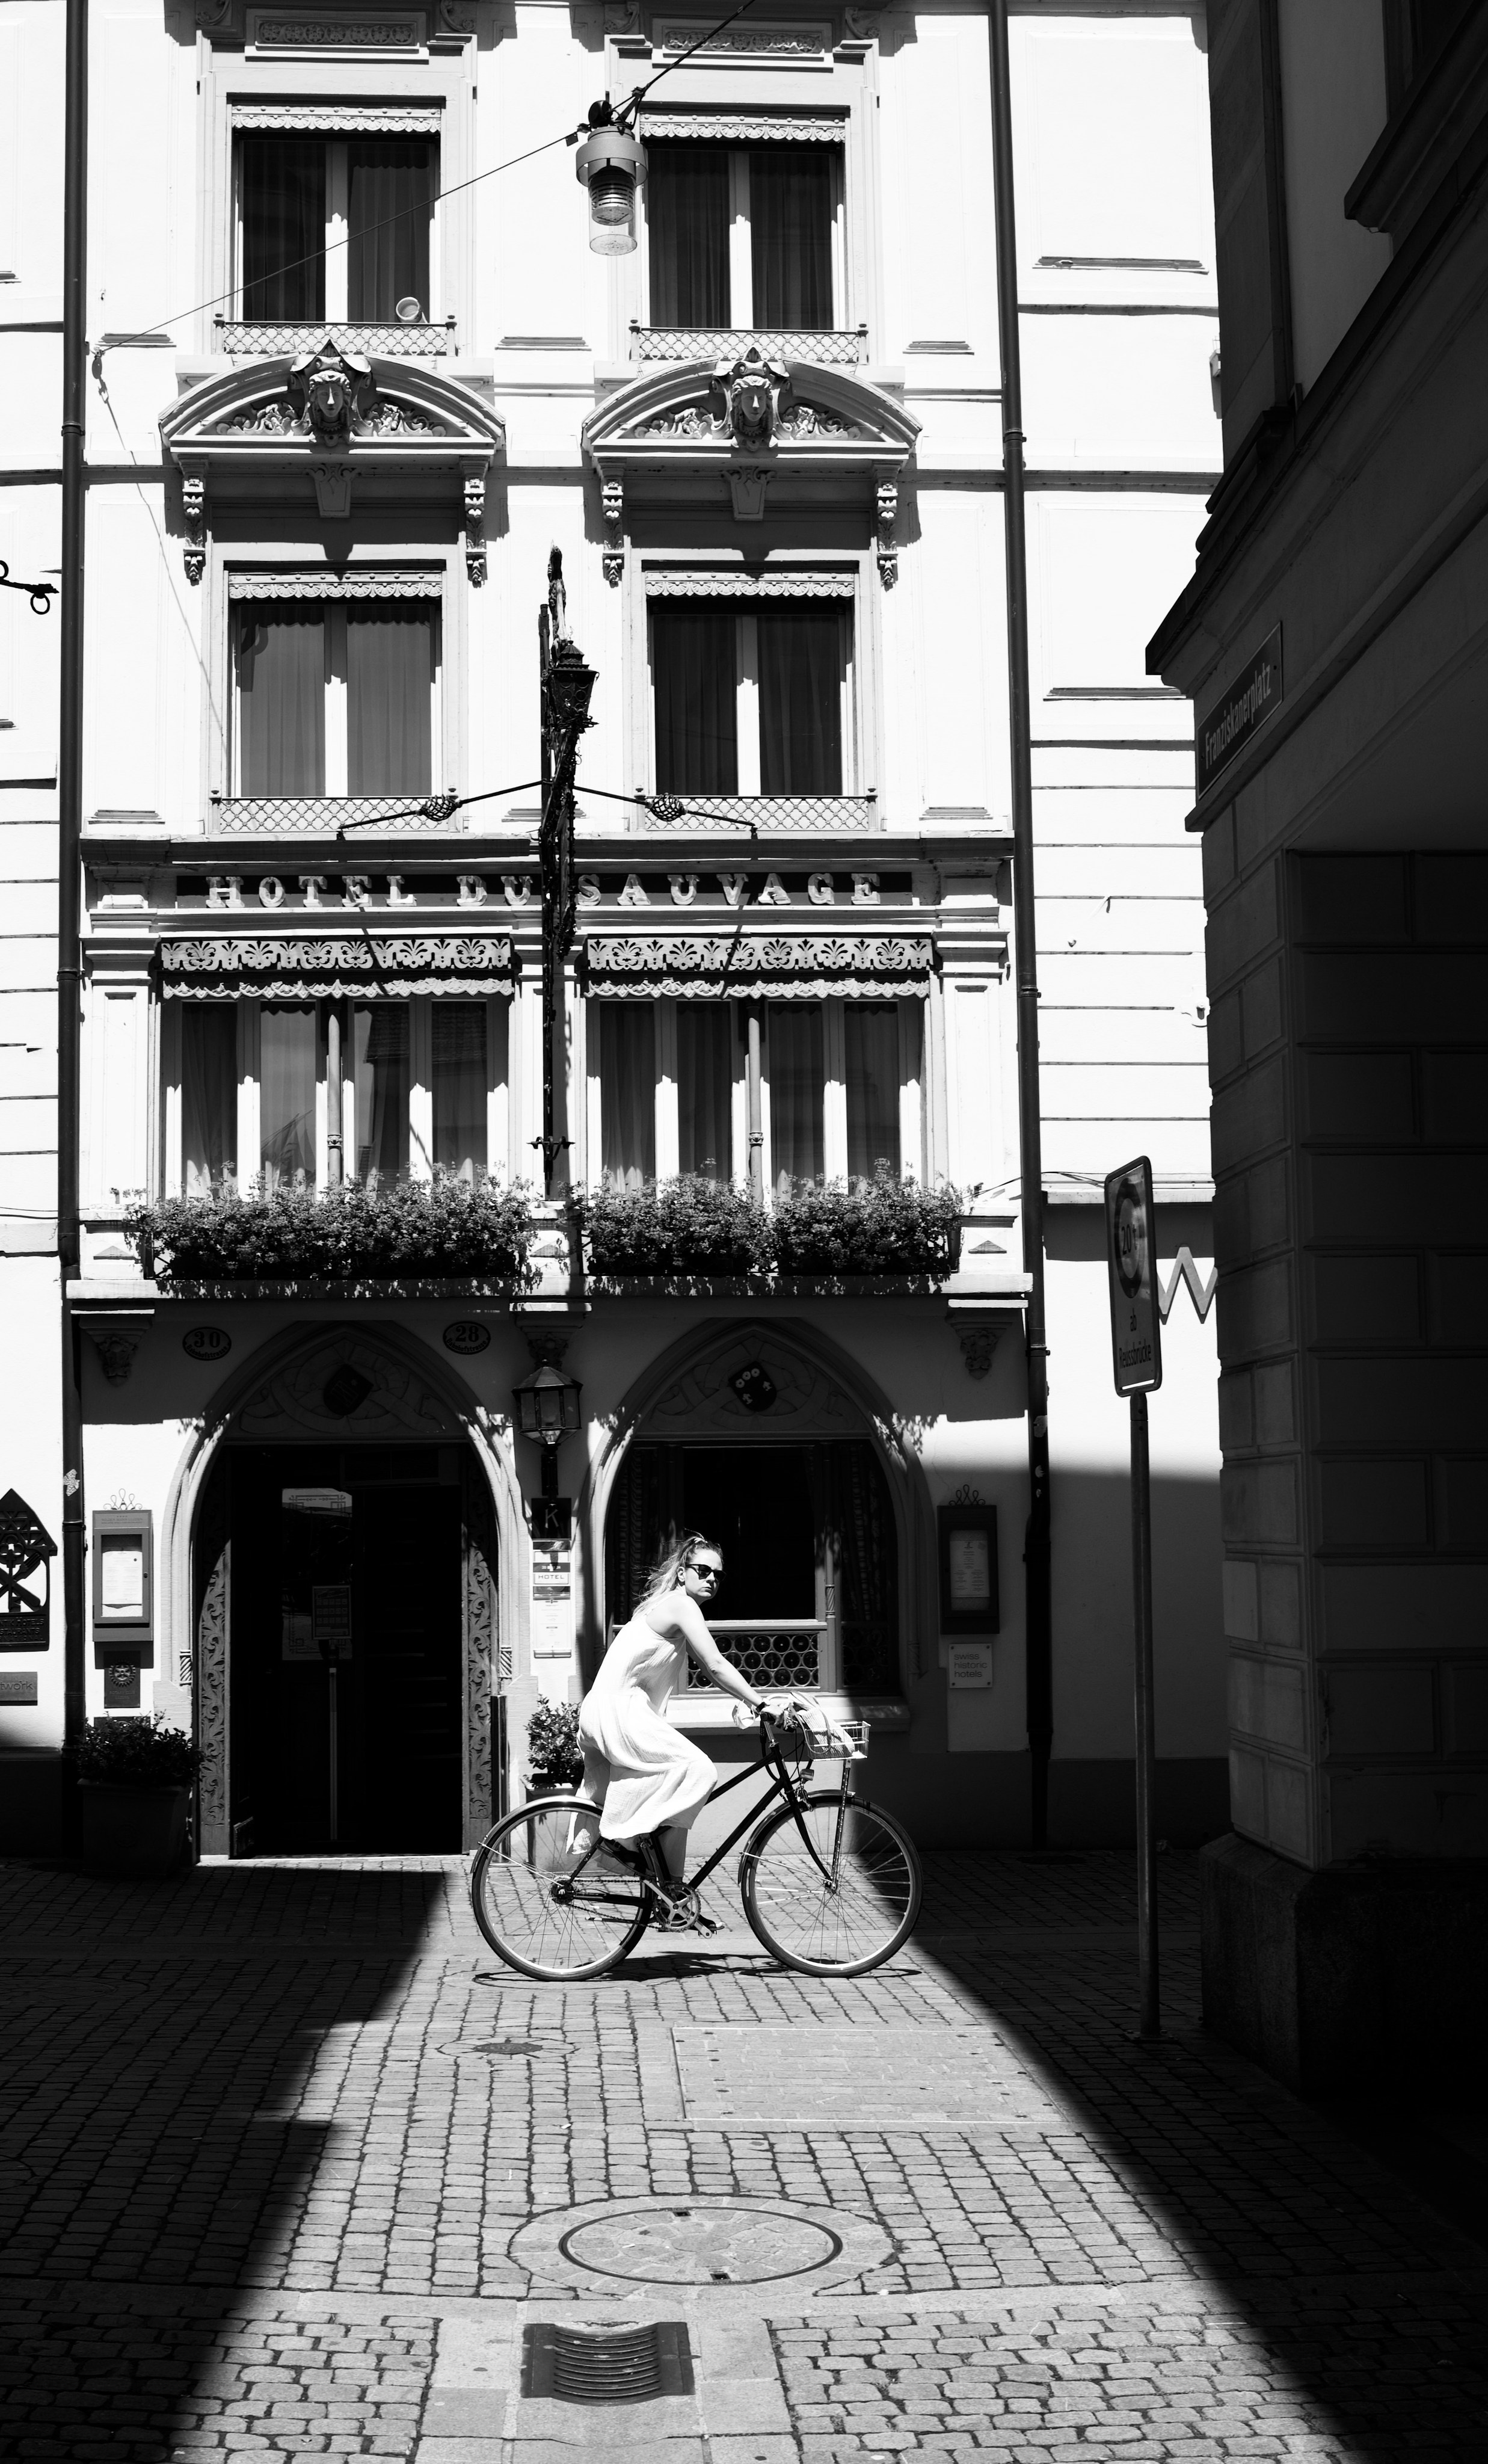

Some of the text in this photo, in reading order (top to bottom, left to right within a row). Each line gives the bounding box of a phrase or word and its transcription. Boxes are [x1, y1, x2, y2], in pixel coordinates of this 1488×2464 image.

[1205, 662, 1271, 770] Franziskanerplatz
[204, 872, 881, 908] HOTEL DU SAUVAGE
[455, 1325, 479, 1342] 28
[1130, 1308, 1137, 1332] ab
[194, 1330, 221, 1348] 30
[1119, 1338, 1151, 1369] Reussbrücke
